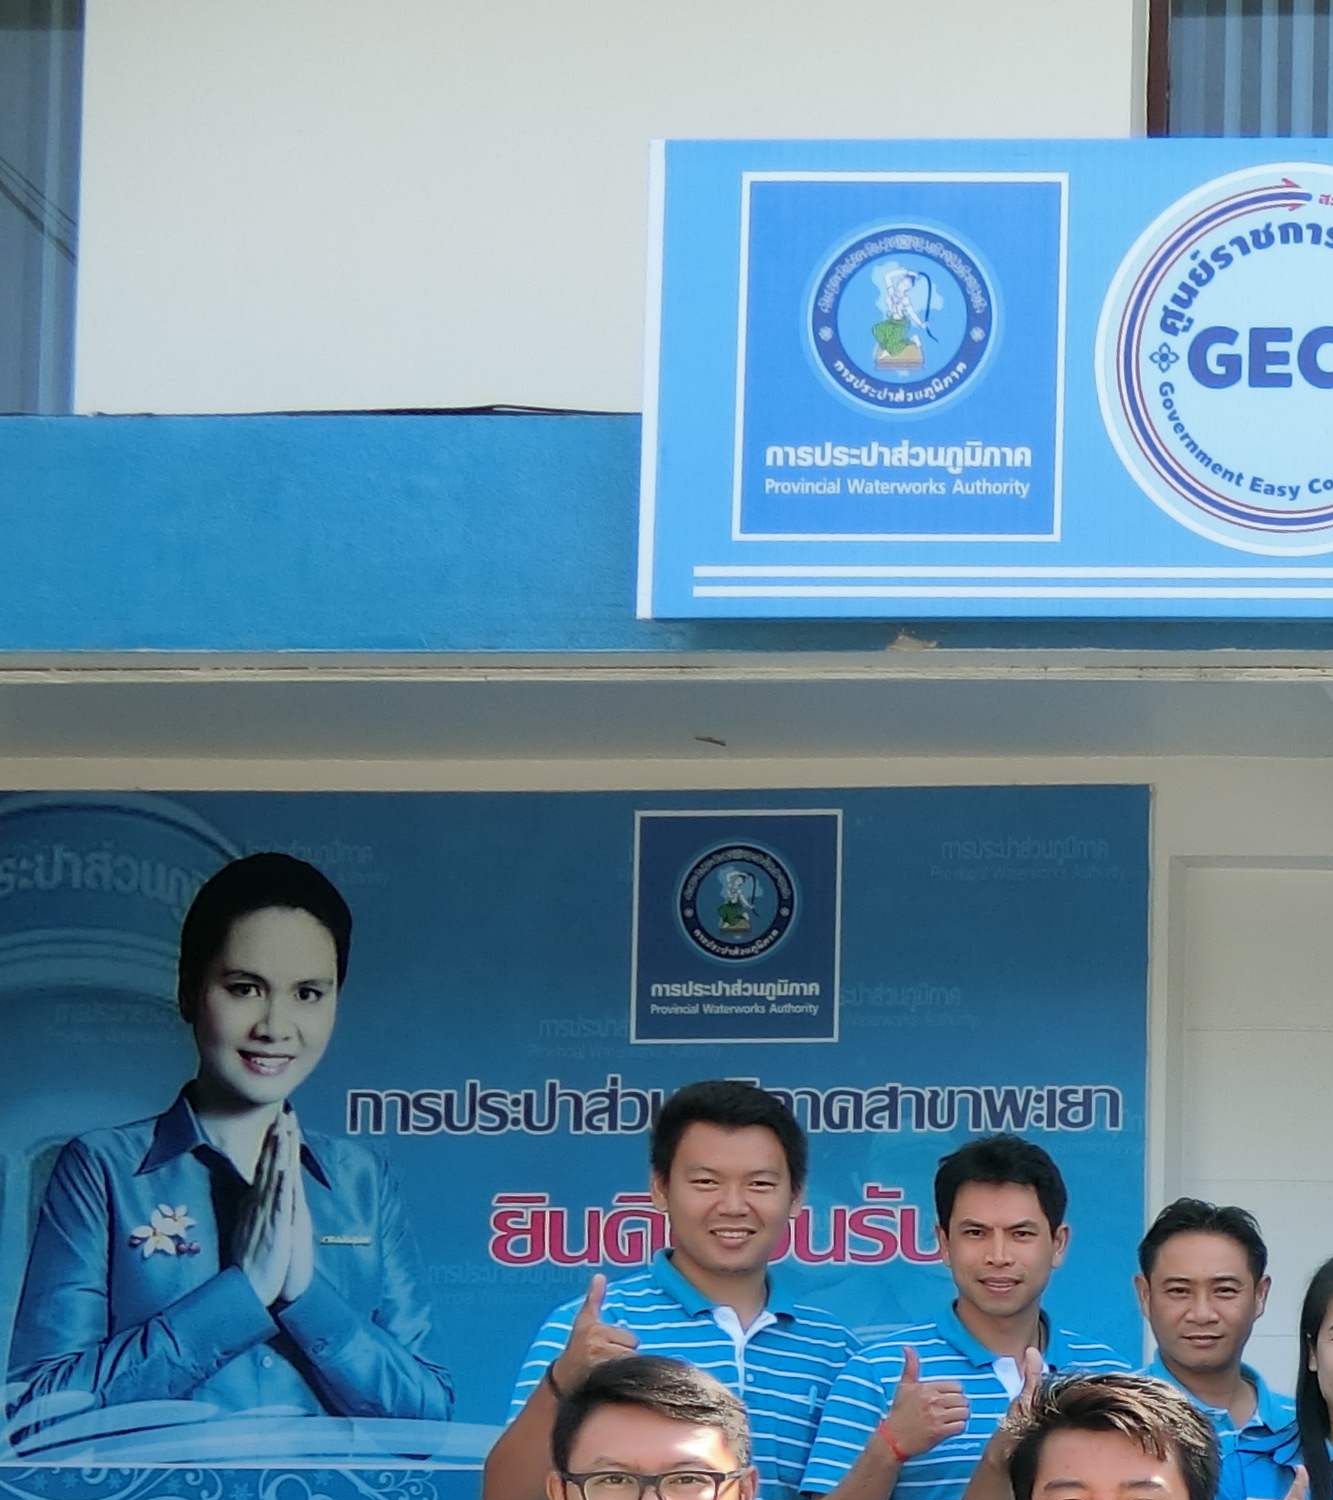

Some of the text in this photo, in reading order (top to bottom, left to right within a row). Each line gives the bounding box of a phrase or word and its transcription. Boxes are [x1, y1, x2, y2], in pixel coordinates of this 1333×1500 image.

[1158, 380, 1244, 487] Government
[1249, 476, 1301, 501] Easy
[764, 439, 1032, 474] การประปาส่วนภูมิภาค
[764, 478, 1030, 499] Provincial Waterworks Authority
[650, 978, 820, 1001] การประปาส่วนภูมิภาค
[650, 1003, 819, 1017] Provincial Waterworks Authority
[346, 1074, 1122, 1134] การประปาส่วิาคสาขาพะเยา
